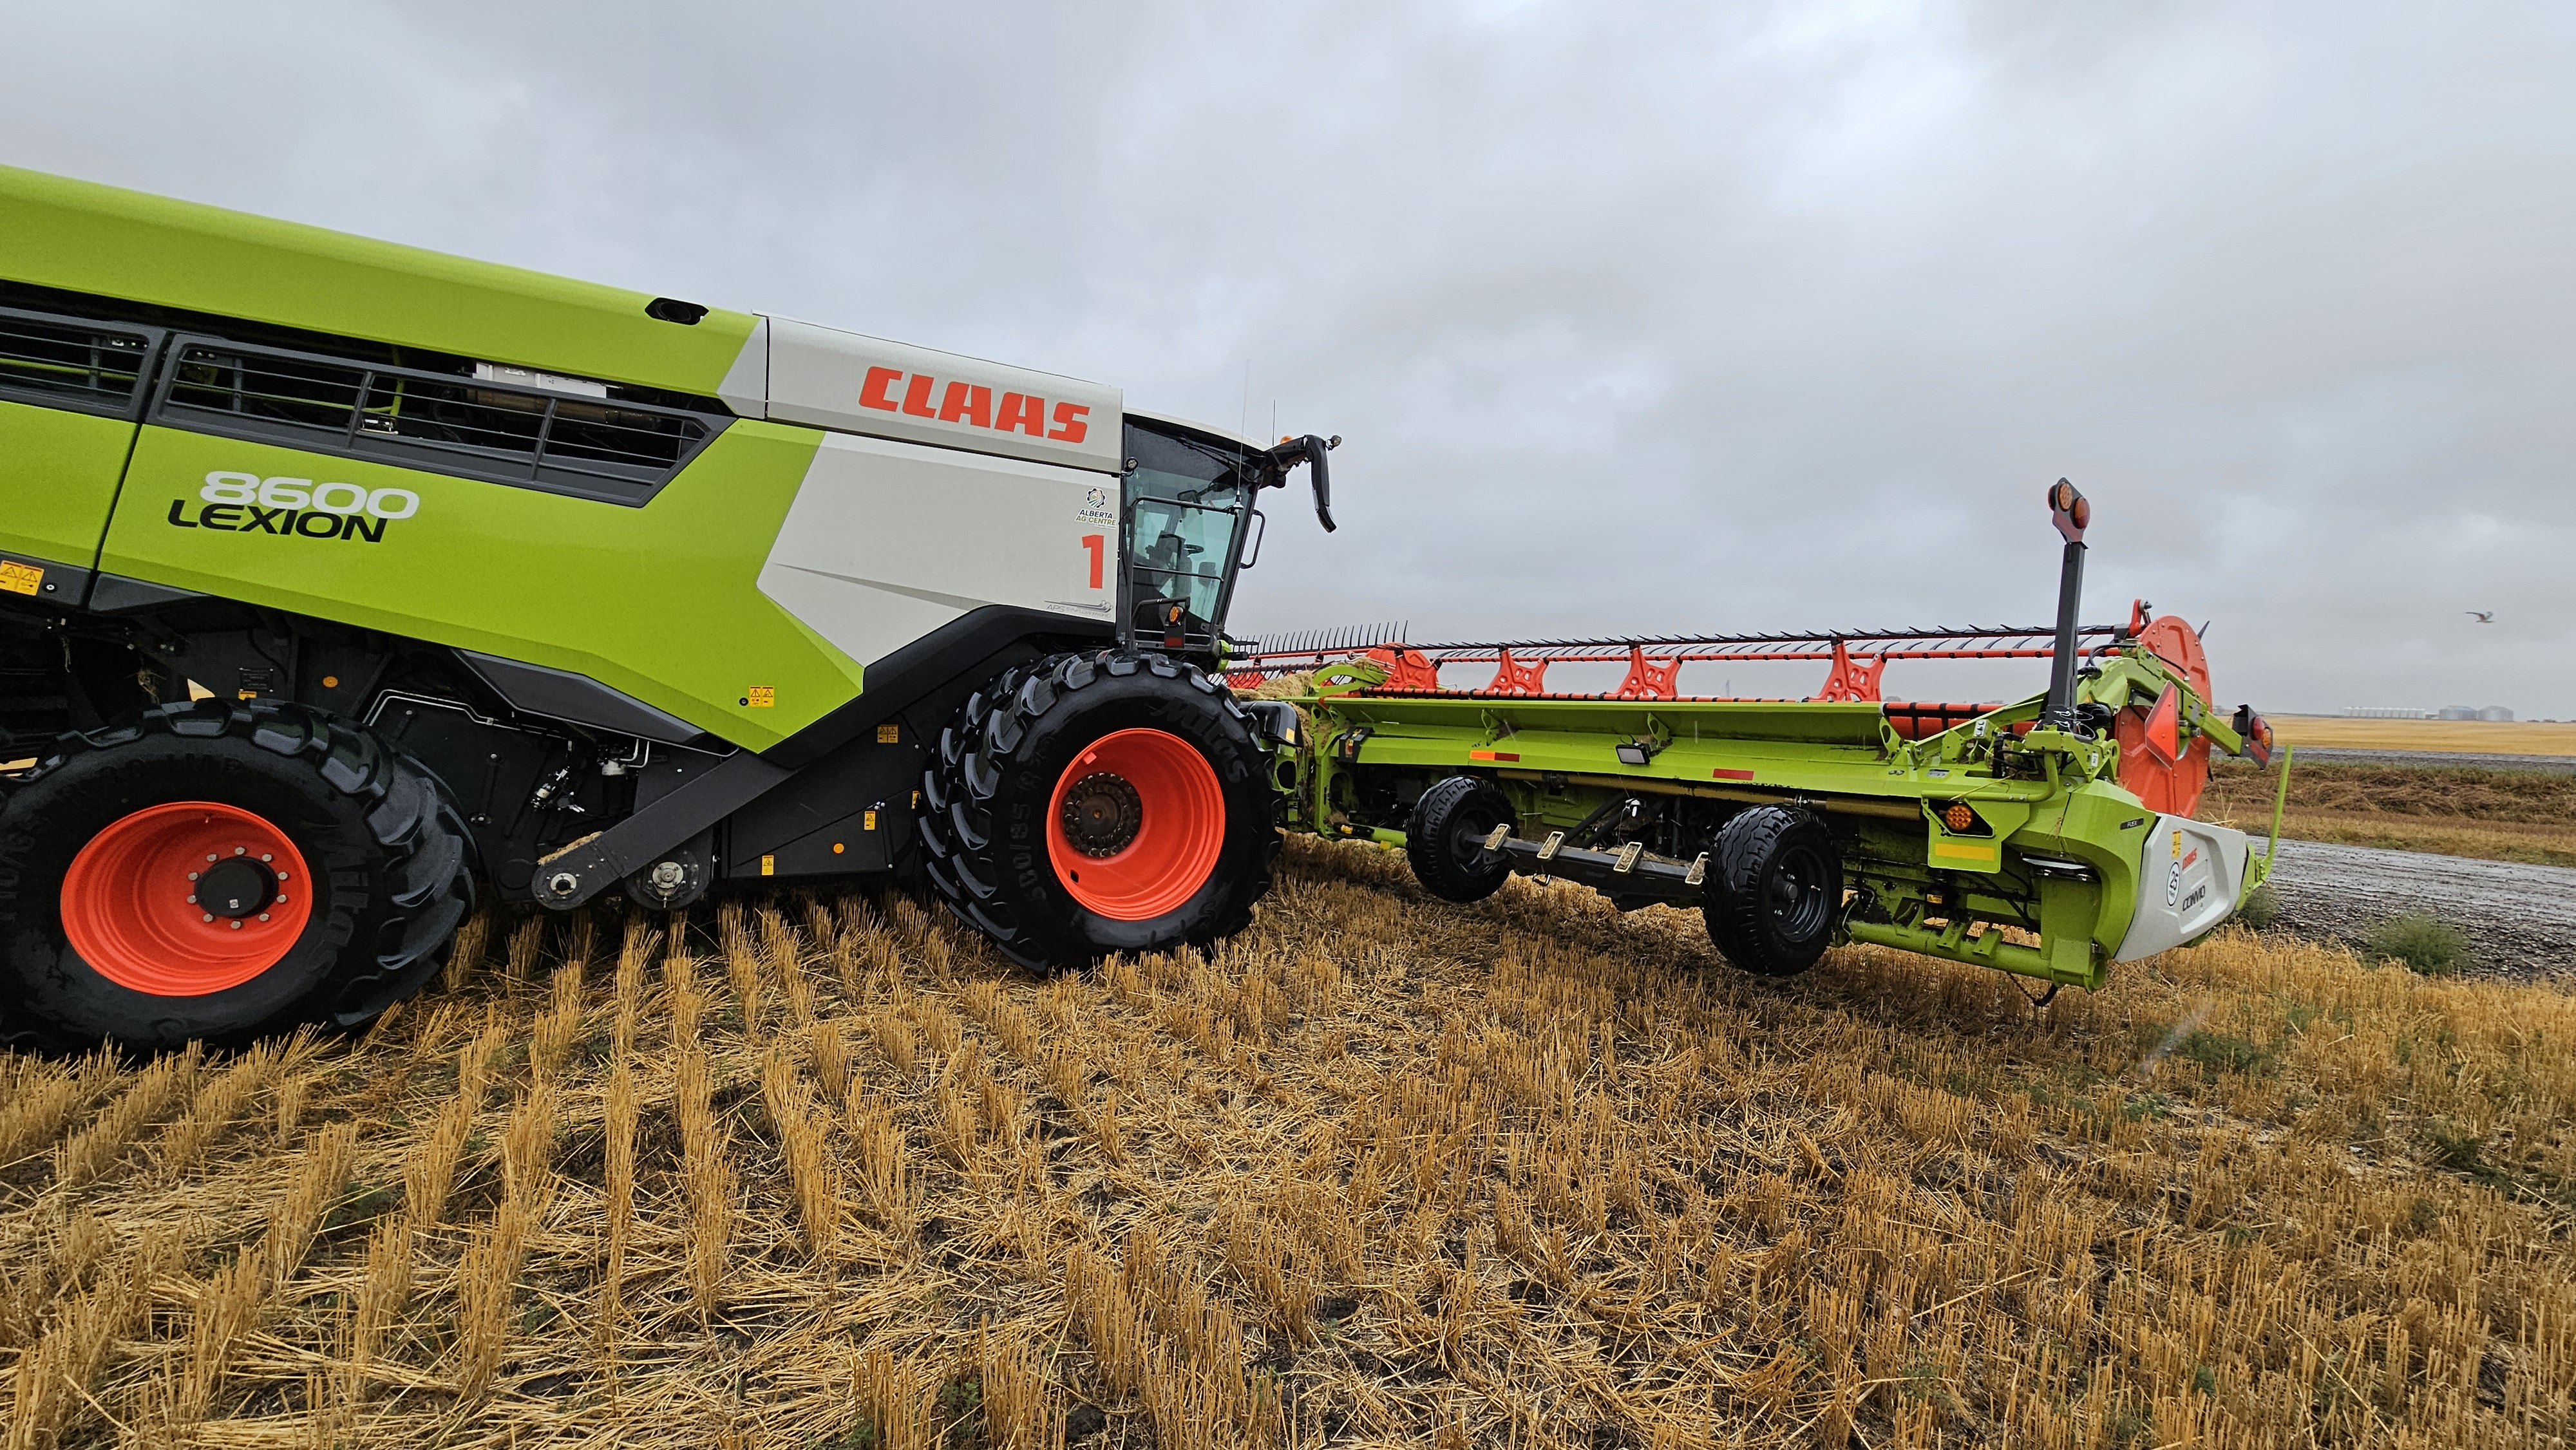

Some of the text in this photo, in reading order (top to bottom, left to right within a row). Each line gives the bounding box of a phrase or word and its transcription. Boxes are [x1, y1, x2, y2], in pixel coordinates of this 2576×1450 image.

[858, 366, 1090, 443] CLAAS
[200, 471, 420, 519] 8600
[1079, 509, 1112, 519] ALBERTA
[167, 499, 388, 543] LEXION
[1088, 517, 1117, 526] CENTRE
[1082, 534, 1104, 588] 1
